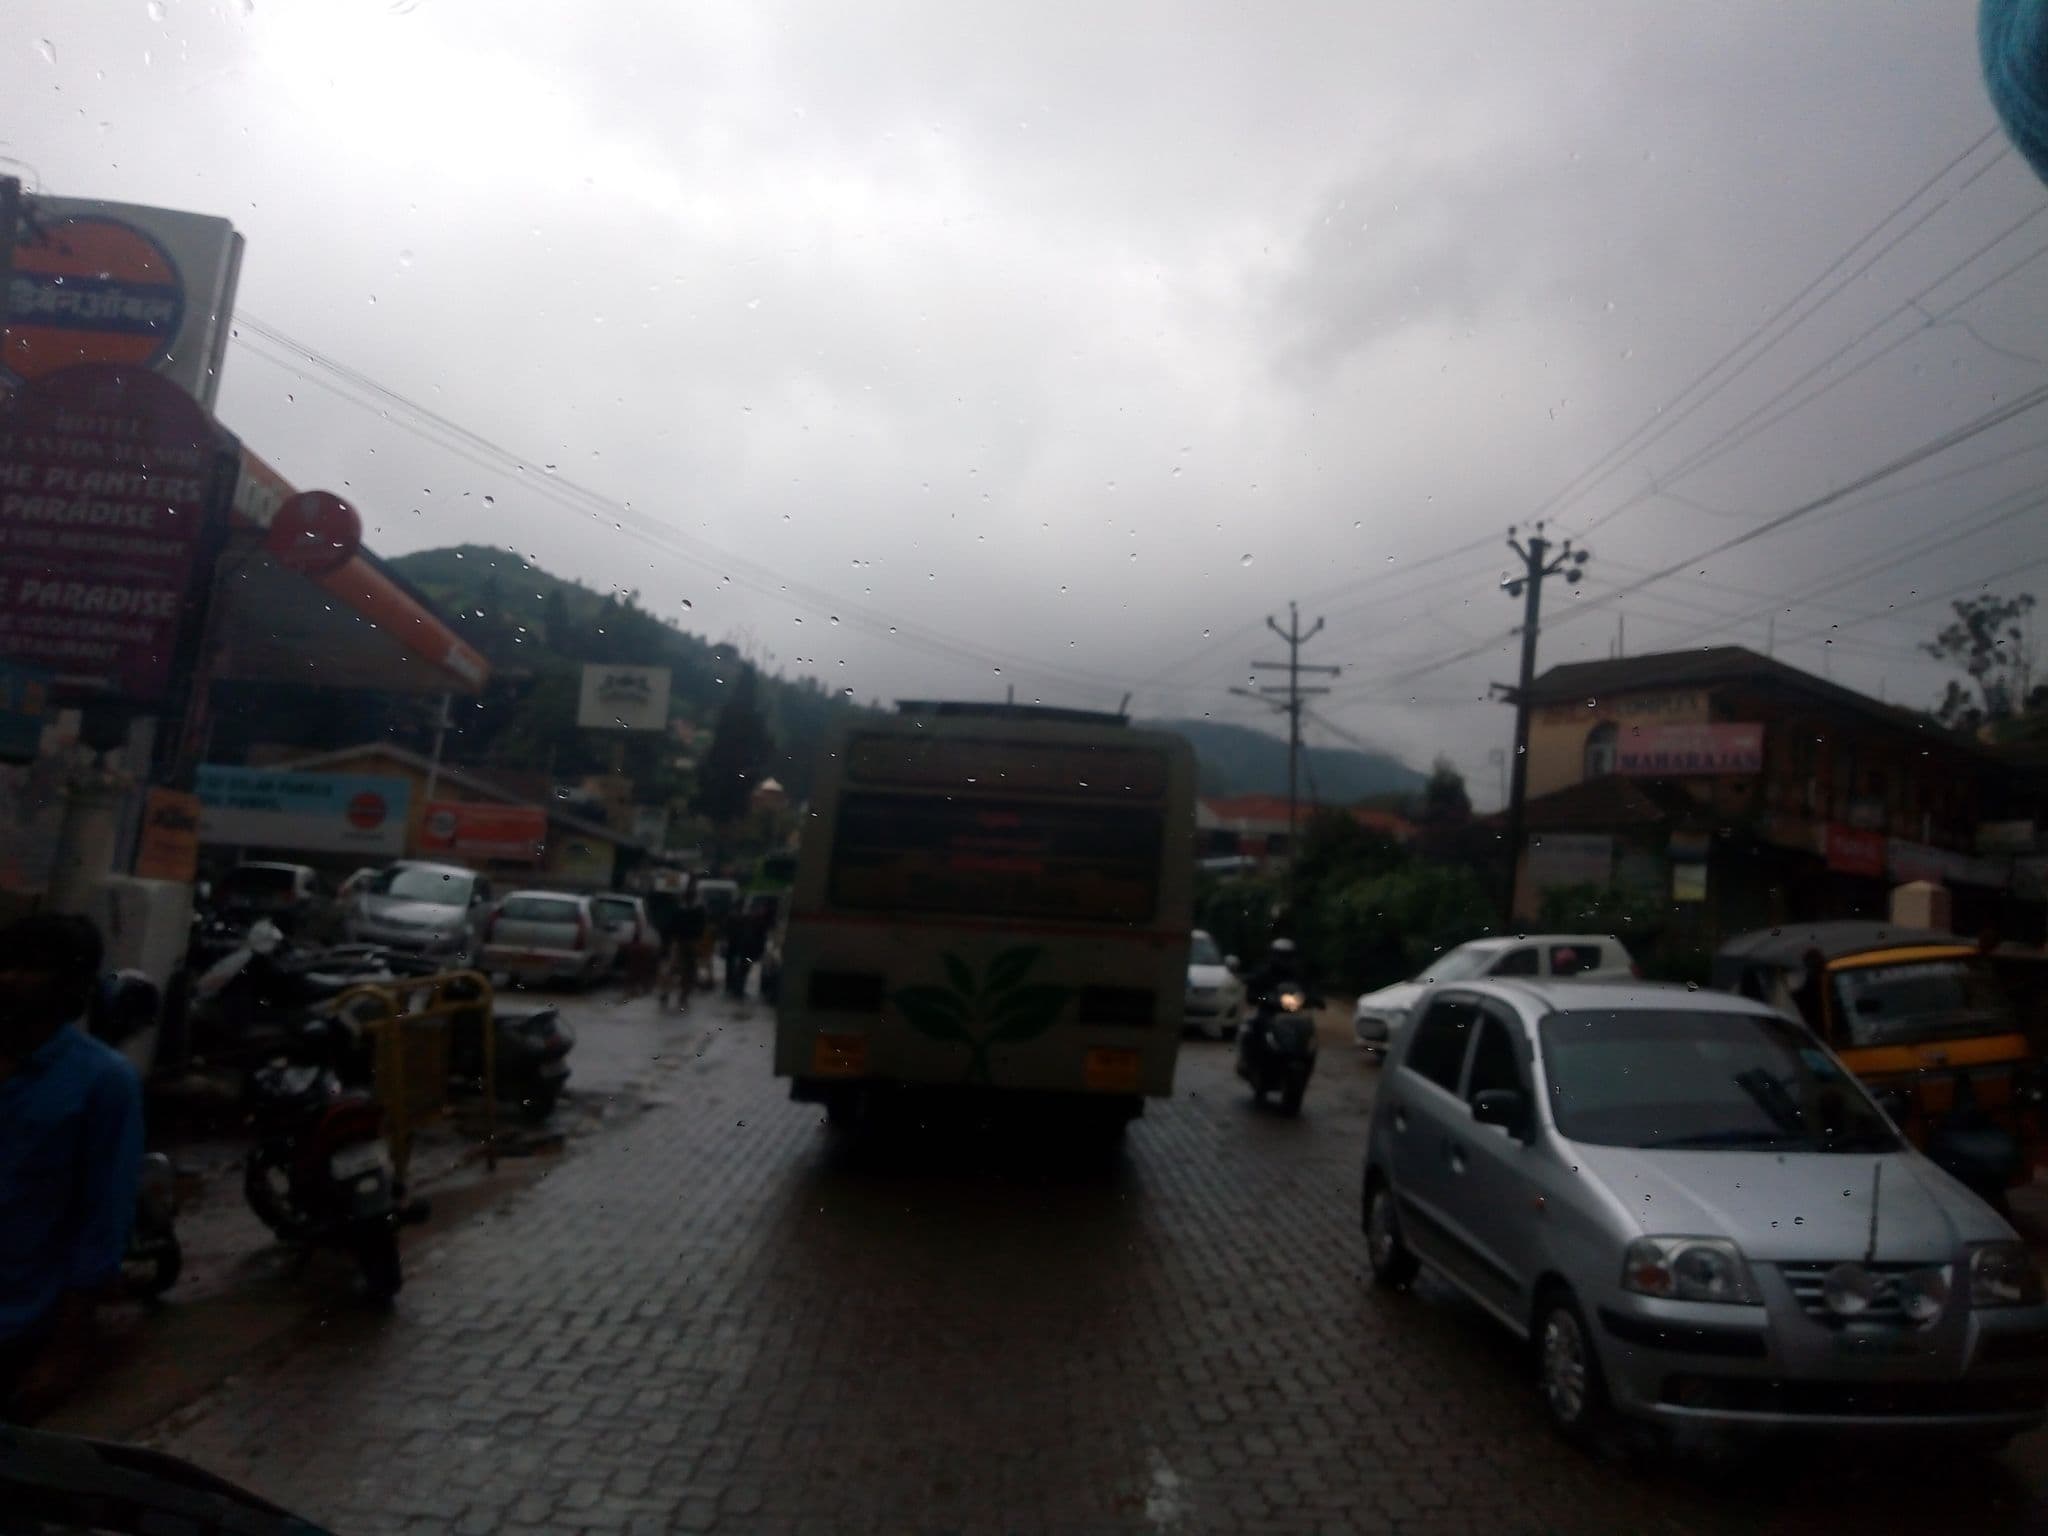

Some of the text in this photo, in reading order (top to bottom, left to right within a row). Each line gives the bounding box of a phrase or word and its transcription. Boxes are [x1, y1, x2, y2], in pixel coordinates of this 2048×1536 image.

[43, 466, 202, 503] PLANTERS
[3, 495, 157, 529] PARADISE
[20, 579, 177, 618] PARADISE
